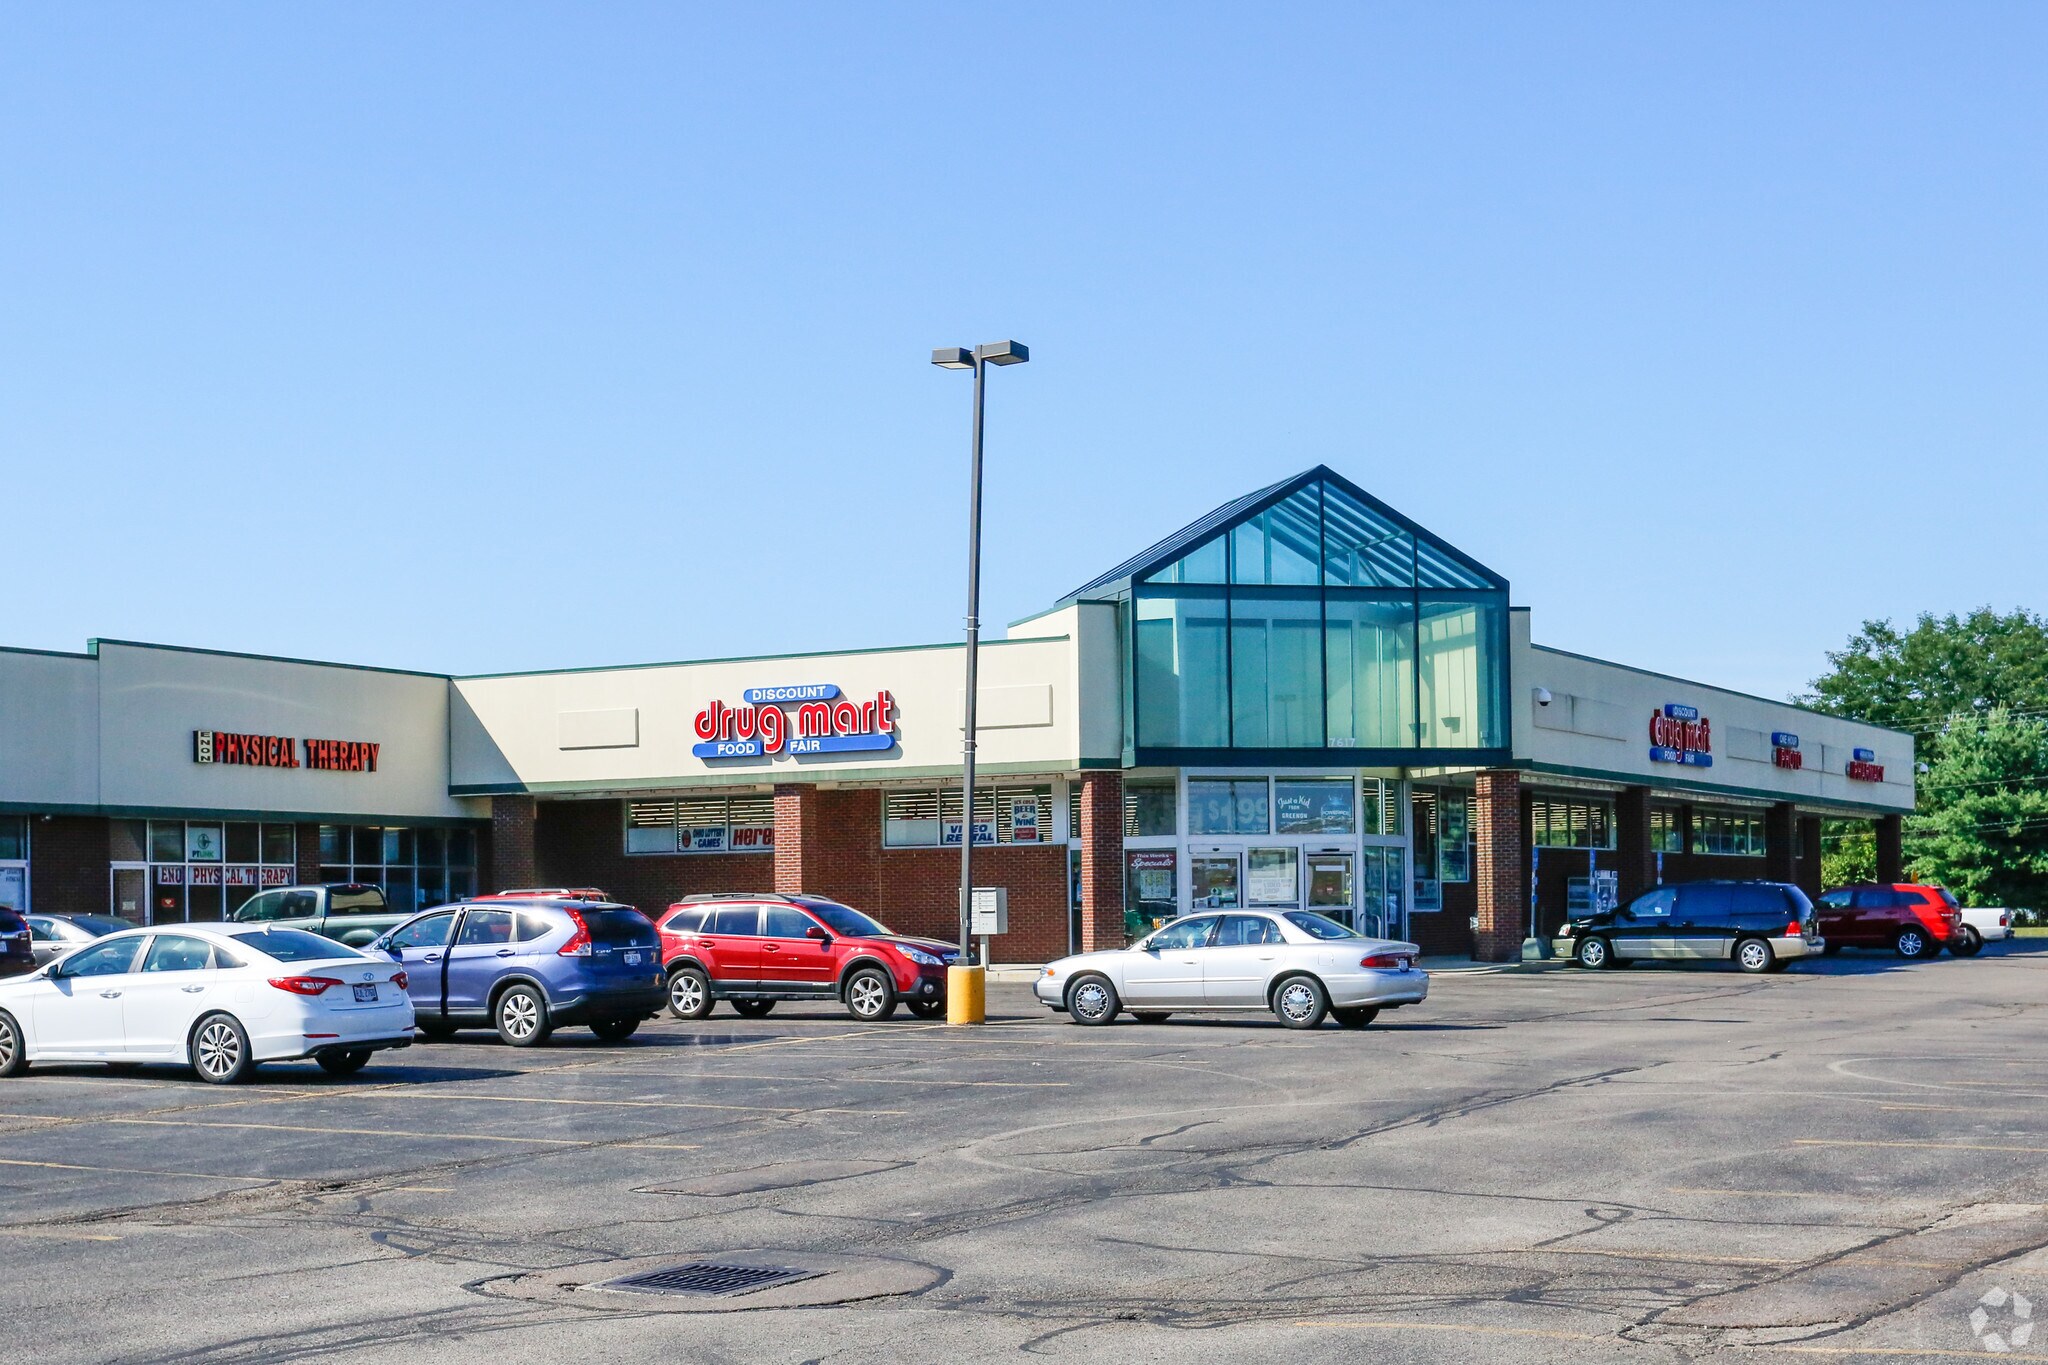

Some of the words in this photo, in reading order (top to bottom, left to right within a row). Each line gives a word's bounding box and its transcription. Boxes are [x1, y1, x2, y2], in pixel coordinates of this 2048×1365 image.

[752, 685, 826, 701] DISCOUNT
[694, 700, 785, 754] drug
[797, 690, 894, 737] mart
[1330, 737, 1356, 747] 7617
[1654, 710, 1682, 762] drug
[1685, 718, 1711, 752] mart
[200, 731, 211, 762] ENON
[215, 731, 299, 768] PHYSICAL
[305, 739, 380, 772] THERAPY
[717, 743, 755, 755] FOOD
[790, 740, 820, 752] FAIR
[1664, 750, 1677, 761] FOOD
[1685, 753, 1695, 763] FAIR
[1014, 805, 1036, 814] BEER
[1014, 817, 1036, 826] WINE
[950, 824, 988, 833] VIEO
[697, 838, 721, 848] GAMES
[946, 833, 994, 842] RETAL
[1131, 858, 1174, 869] Specials
[193, 867, 243, 884] PHYSCAL
